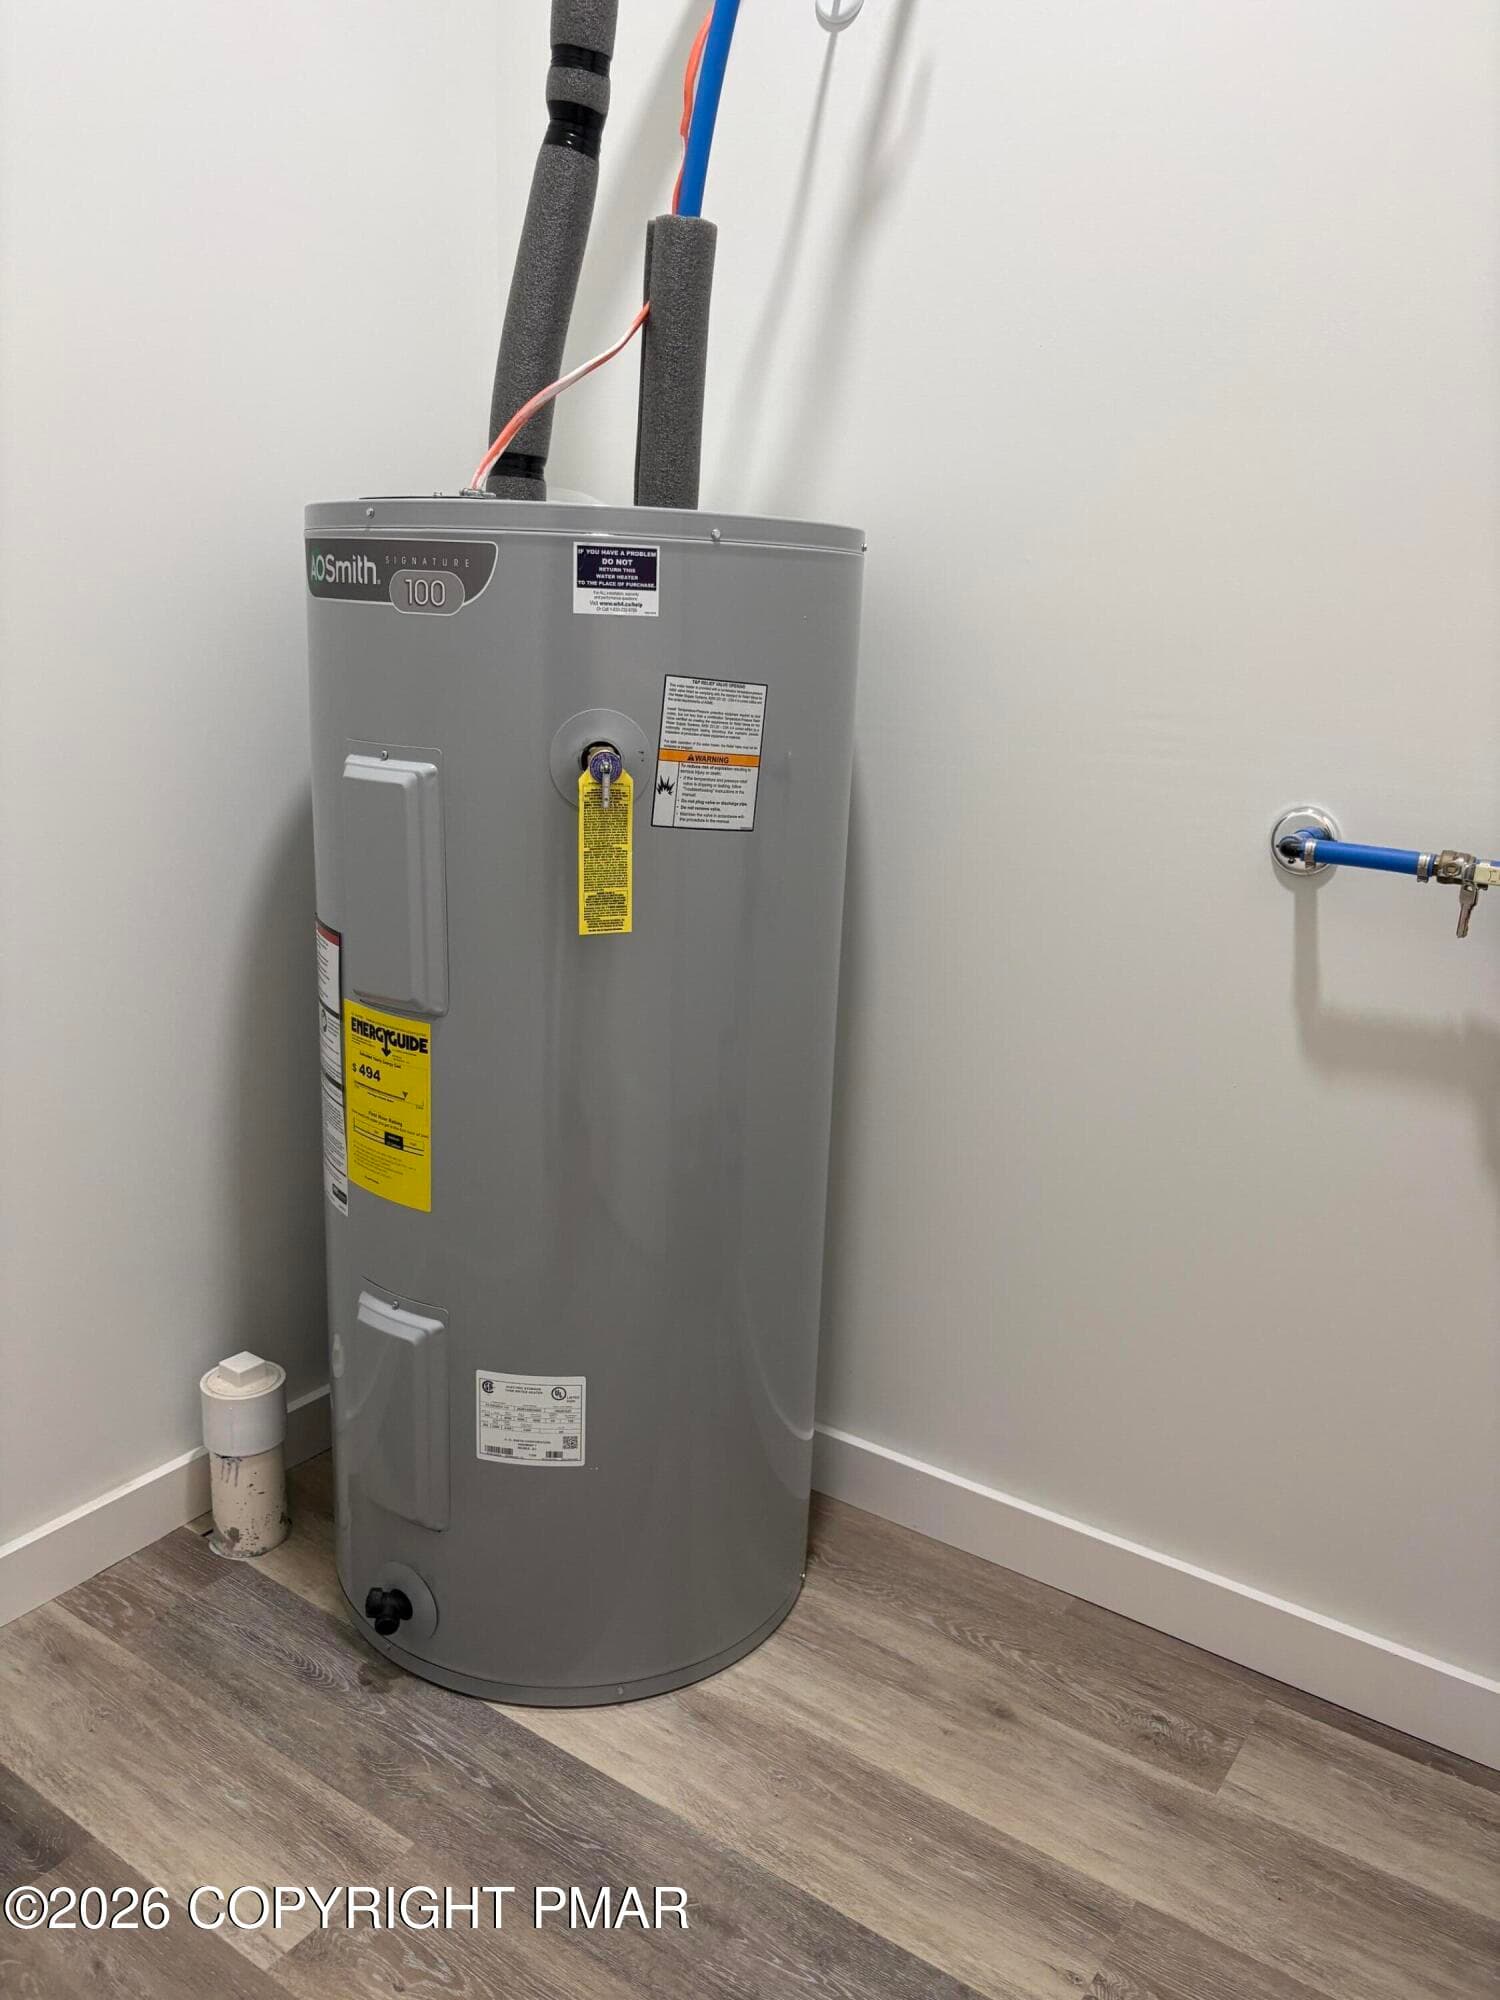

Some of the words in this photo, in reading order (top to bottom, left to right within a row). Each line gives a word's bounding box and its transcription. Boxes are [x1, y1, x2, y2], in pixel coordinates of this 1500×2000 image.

[385, 555, 470, 568] SIGNATURE
[405, 579, 446, 607] 100
[695, 754, 729, 764] WARNING
[359, 1064, 381, 1082] 494
